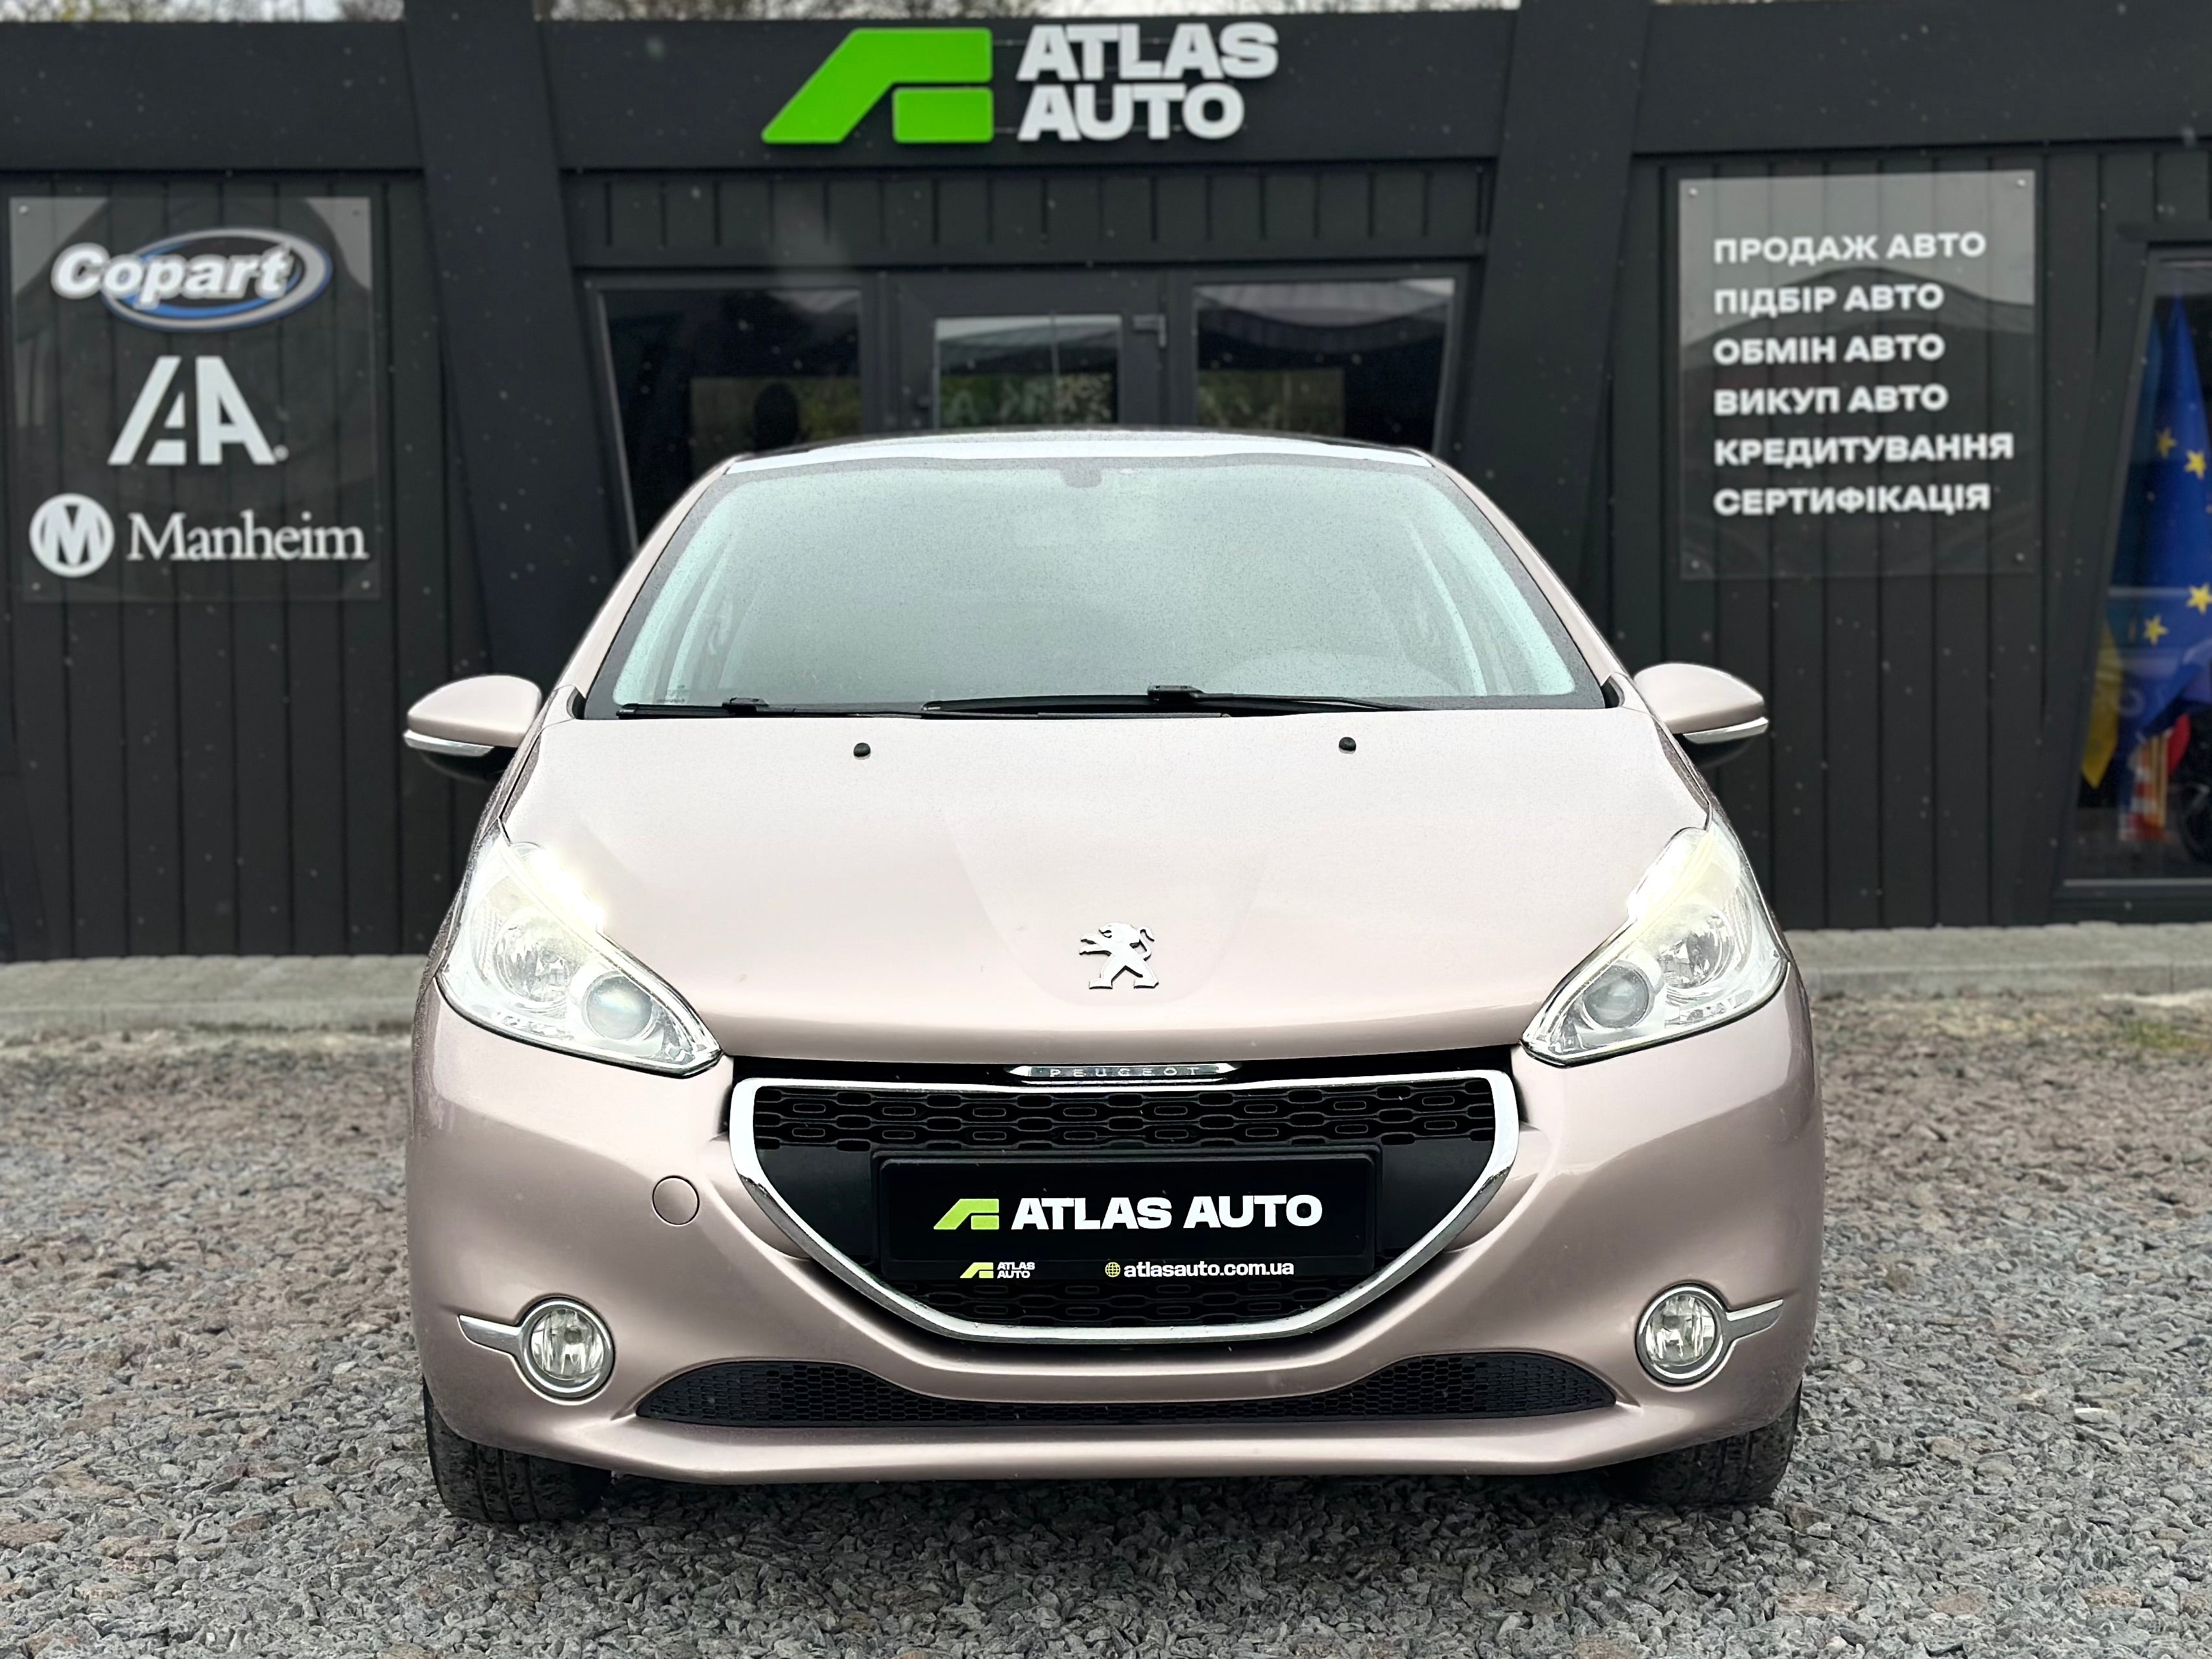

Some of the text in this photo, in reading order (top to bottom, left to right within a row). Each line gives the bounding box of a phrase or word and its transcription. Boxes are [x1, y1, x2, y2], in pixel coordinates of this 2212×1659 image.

[1016, 22, 1279, 81] ATLAS
[1017, 82, 1245, 141] AUTO
[1714, 231, 1987, 266] ПРОДАЖ АВТО
[51, 242, 293, 309] Copart
[1714, 282, 1945, 318] ПІДБІР АВТО
[1712, 332, 1945, 365] ОБМІН АВТО
[1714, 383, 1949, 415] ВИКУП АВТО
[1714, 432, 2013, 469] КРЕДИТУВАННЯ
[1713, 484, 1991, 515] СЕРТИФІКАЦІЯ
[127, 509, 369, 561] Manheim
[1049, 1067, 1200, 1077] PEUGEOT
[1010, 1194, 1323, 1230] ATLAS AUTO
[996, 1261, 1036, 1270] ATLAS
[996, 1270, 1031, 1279] AUTO
[1124, 1260, 1295, 1278] atlasauto.com.ua
